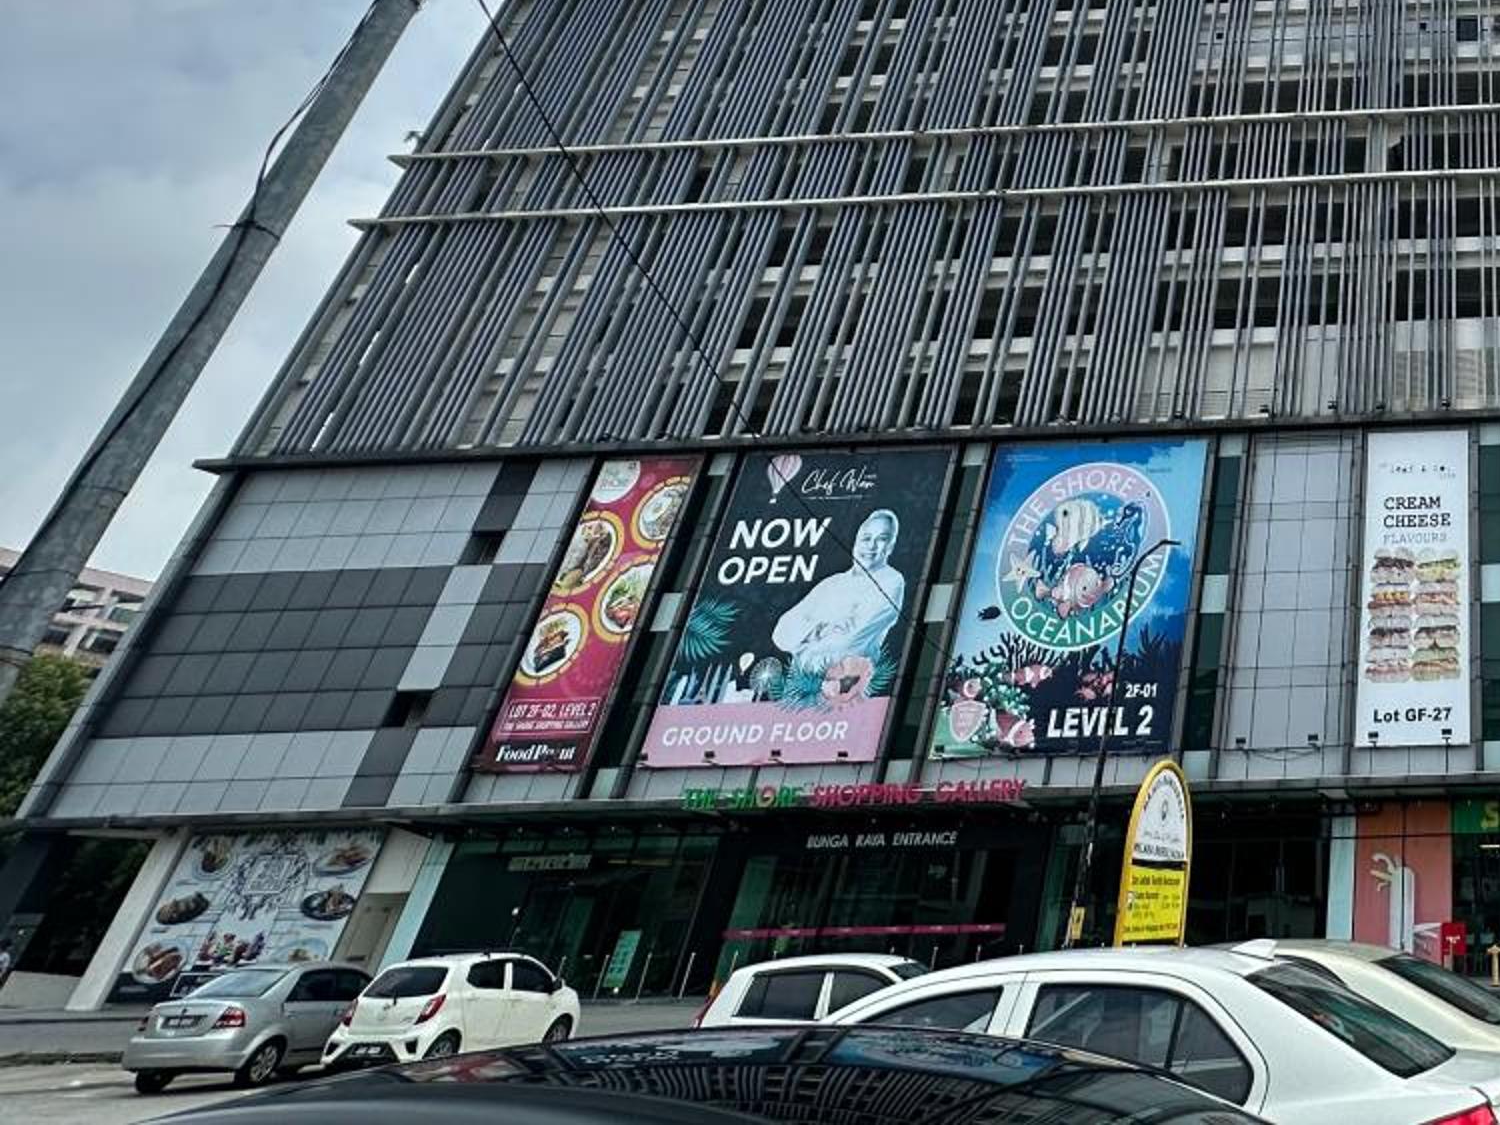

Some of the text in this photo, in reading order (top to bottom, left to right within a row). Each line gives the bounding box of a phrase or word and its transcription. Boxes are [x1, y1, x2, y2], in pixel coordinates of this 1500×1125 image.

[1008, 468, 1137, 547] THE SHORE
[1383, 495, 1441, 510] CREAM
[1383, 512, 1451, 528] CHEESE
[729, 517, 832, 550] NOW
[717, 554, 819, 585] OPEN
[1124, 682, 1158, 698] 2F-01
[510, 702, 529, 718] LOT
[1136, 704, 1153, 735] 2
[1373, 706, 1453, 724] Lot GF-27
[662, 720, 849, 747] GROUND FLOOR
[682, 778, 1027, 811] THE SHORE SHOPPING GALLERY
[806, 831, 959, 849] BUNGA RAYA ENTRANCE
